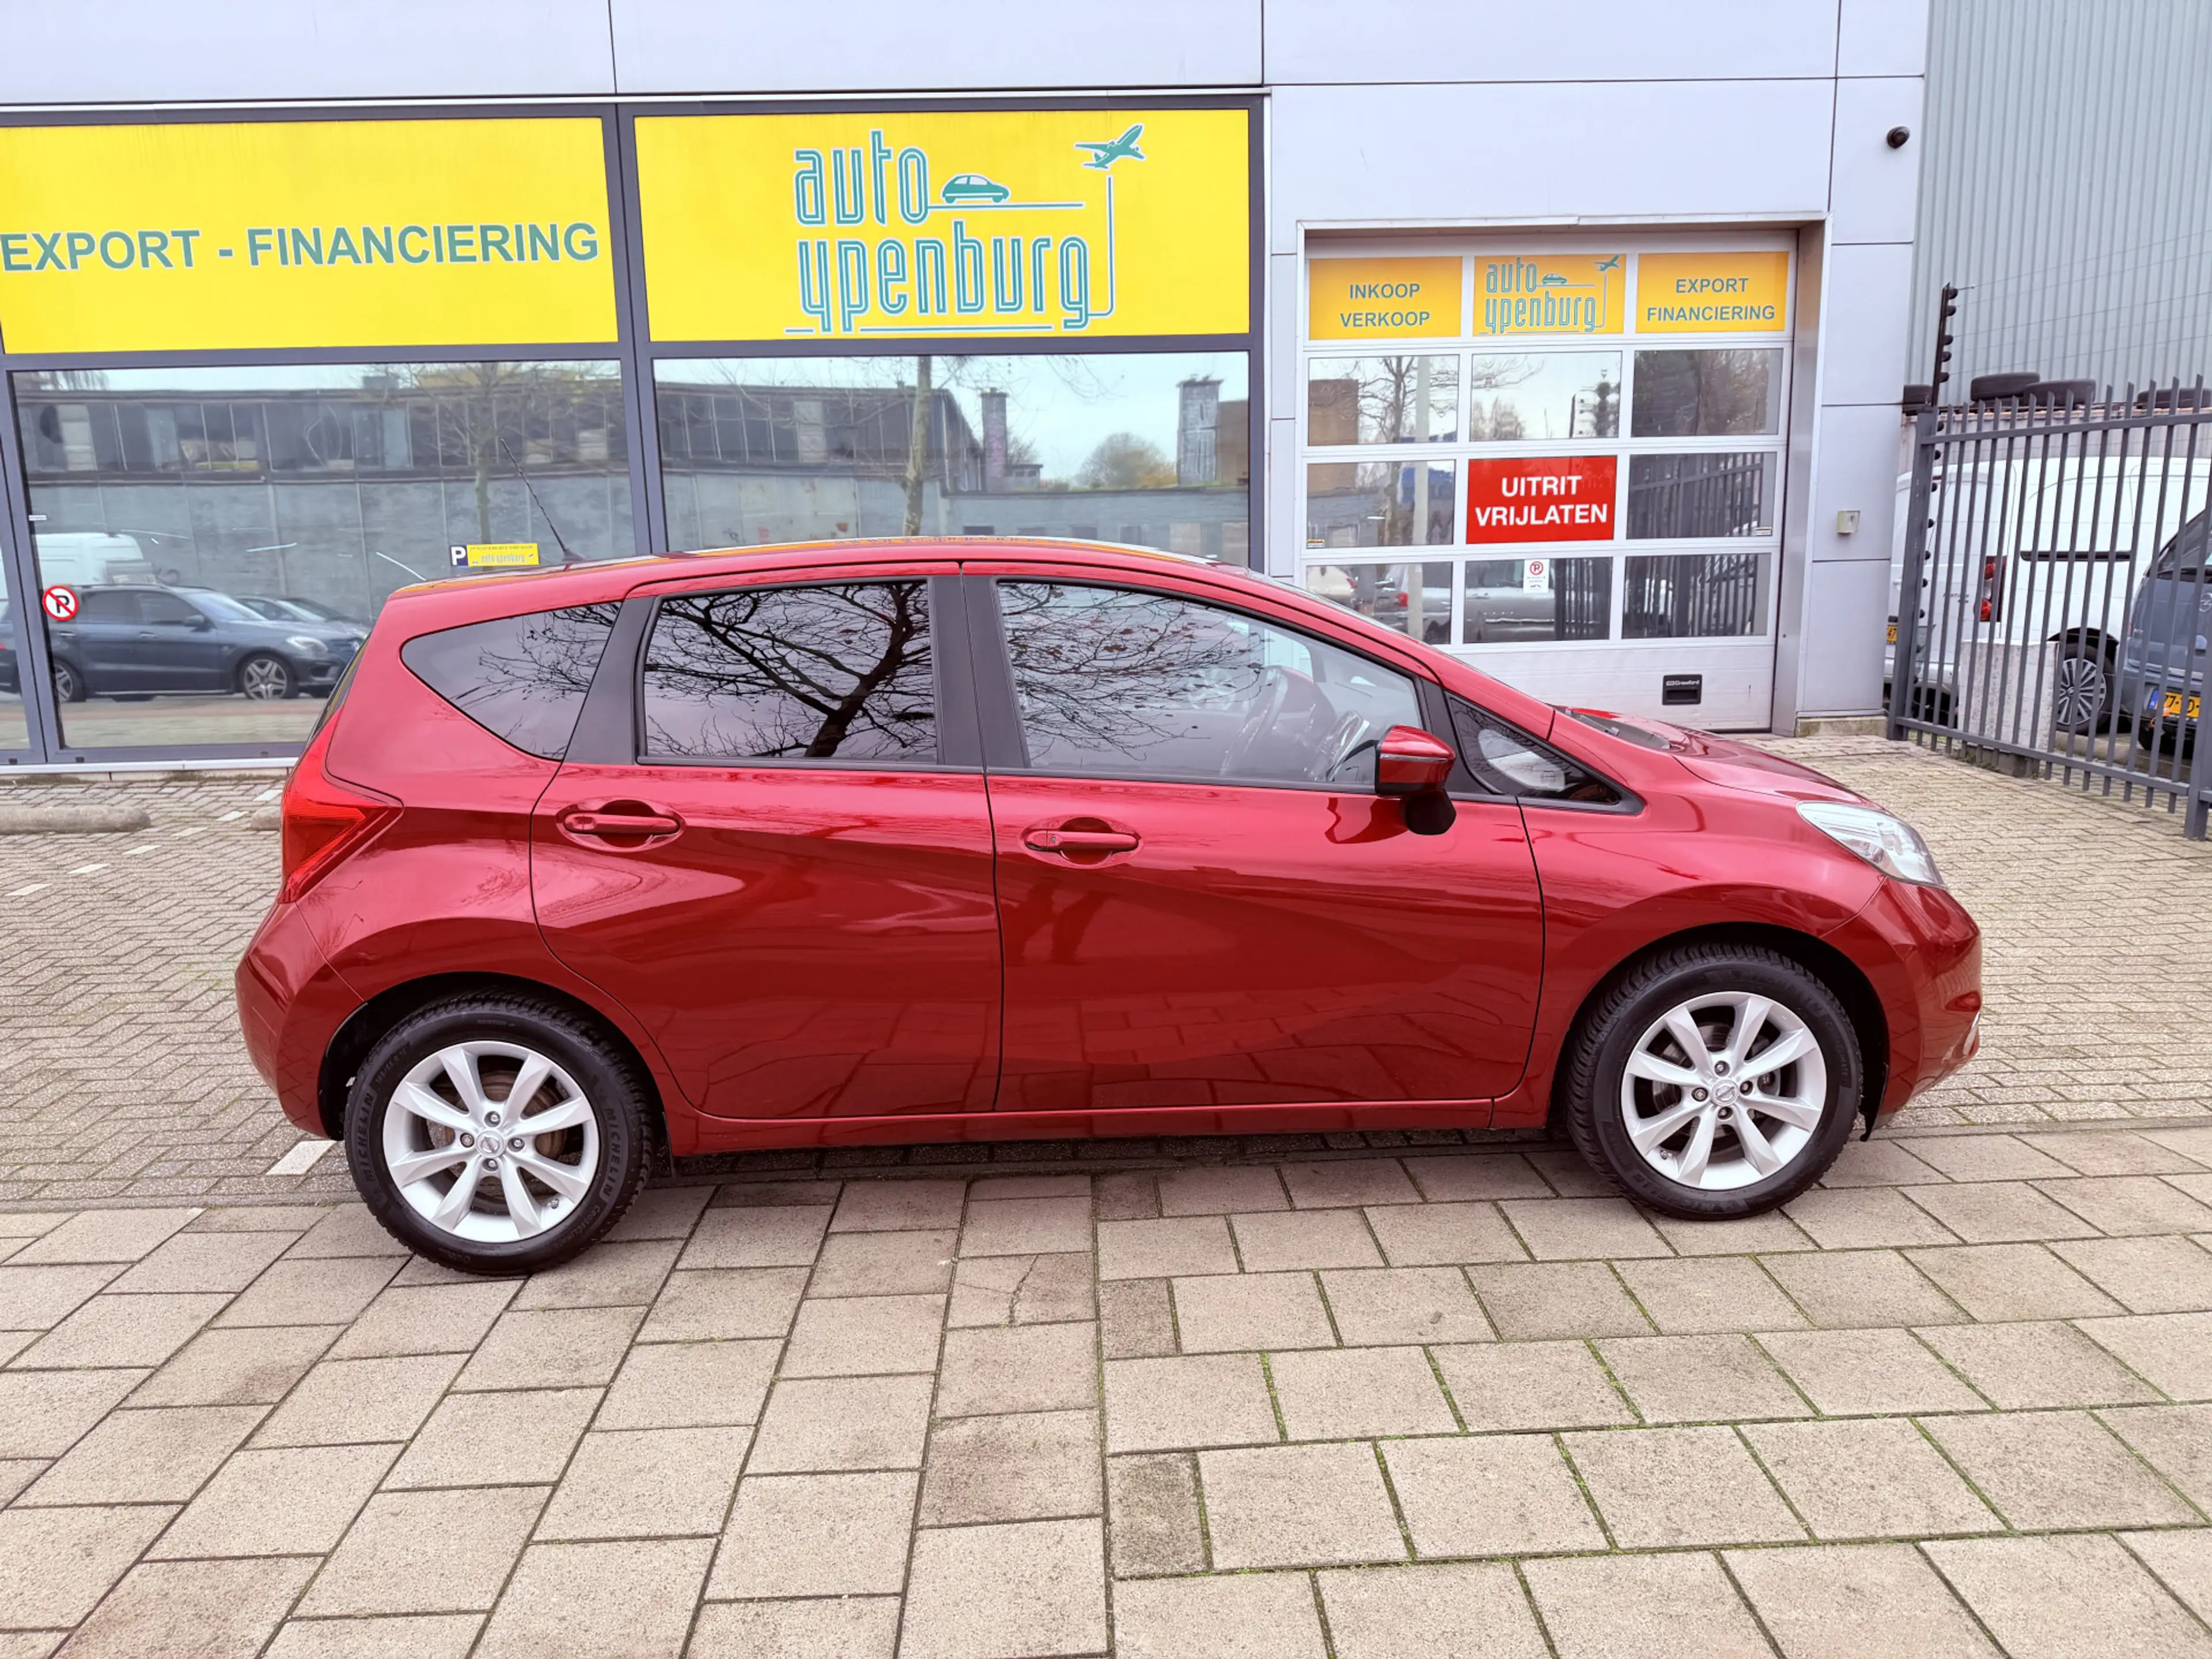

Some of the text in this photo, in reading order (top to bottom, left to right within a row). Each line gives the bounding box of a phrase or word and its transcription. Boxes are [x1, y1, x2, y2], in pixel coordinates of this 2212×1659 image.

[794, 129, 929, 226] auto
[0, 229, 200, 272] EXPORT
[247, 222, 600, 267] FINANCIERING
[797, 219, 1089, 333] ypenburg
[1486, 257, 1537, 293] auto
[1675, 277, 1749, 294] EXPORT
[1349, 283, 1421, 299] INKOOP
[1340, 310, 1430, 327] VERKOOP
[1485, 290, 1596, 334] ypenburg
[1647, 305, 1775, 322] FINANCIERING
[1501, 475, 1582, 498] UITRIT
[1475, 502, 1608, 527] VRIJLATEN
[451, 546, 466, 565] P
[357, 1093, 375, 1181] MICHELIN
[603, 1108, 621, 1197] MICHELIN
